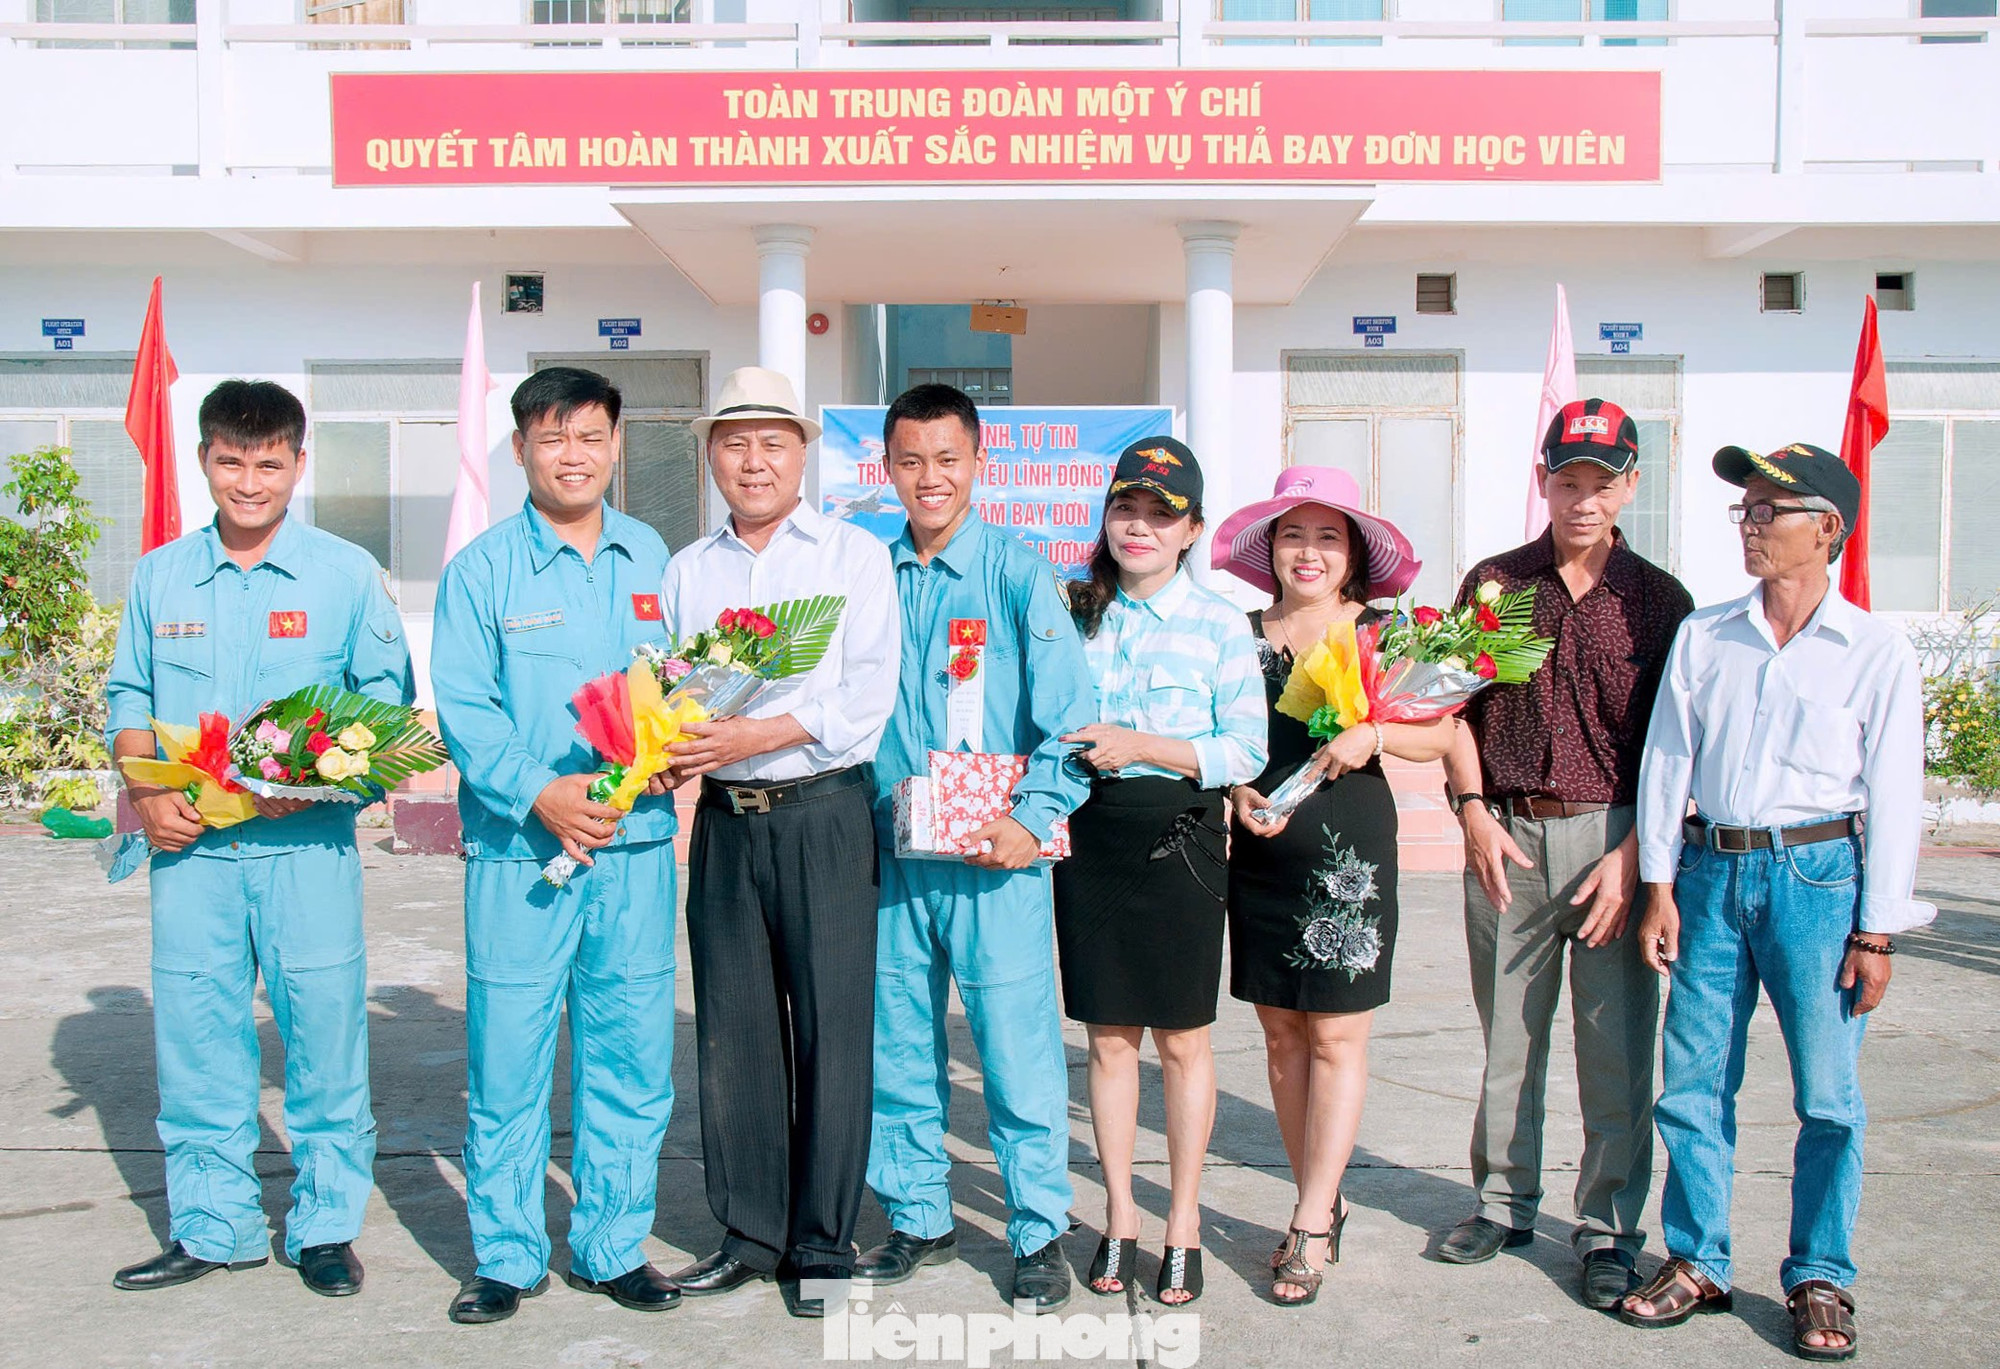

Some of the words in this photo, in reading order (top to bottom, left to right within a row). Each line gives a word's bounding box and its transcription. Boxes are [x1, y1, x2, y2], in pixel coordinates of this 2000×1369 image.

[724, 82, 818, 119] TOÀN
[830, 87, 951, 119] TRUNG
[962, 81, 1063, 118] ĐOÀN
[1077, 81, 1155, 124] MỘT
[1166, 80, 1188, 117] Ý
[1201, 81, 1263, 118] CHÍ
[366, 128, 479, 171] QUYẾT
[489, 131, 567, 168] TÂM
[579, 130, 678, 167] HOÀN
[689, 130, 810, 167] THÀNH
[822, 125, 914, 166] XUẤT
[925, 124, 997, 165] SẮC
[1010, 128, 1133, 171] NHIỆM
[1145, 134, 1192, 171] VỤ
[1203, 125, 1273, 165] THẢ
[1283, 134, 1354, 165] BAY
[1364, 130, 1441, 166] ĐƠN
[1453, 134, 1527, 172] HỌC
[1538, 128, 1626, 166] VIÊN
[1366, 337, 1382, 345] A03
[1612, 343, 1628, 351] A04
[979, 420, 1015, 450] ĨNH,
[1021, 423, 1045, 453] TỰ
[1048, 425, 1078, 448] TIN
[856, 462, 893, 486] TRU
[1014, 459, 1052, 487] LĨNH
[1057, 459, 1103, 492] ĐỘNG
[972, 498, 1006, 525] ÂM
[1012, 502, 1046, 526] BAY
[1052, 501, 1089, 526] ĐƠN
